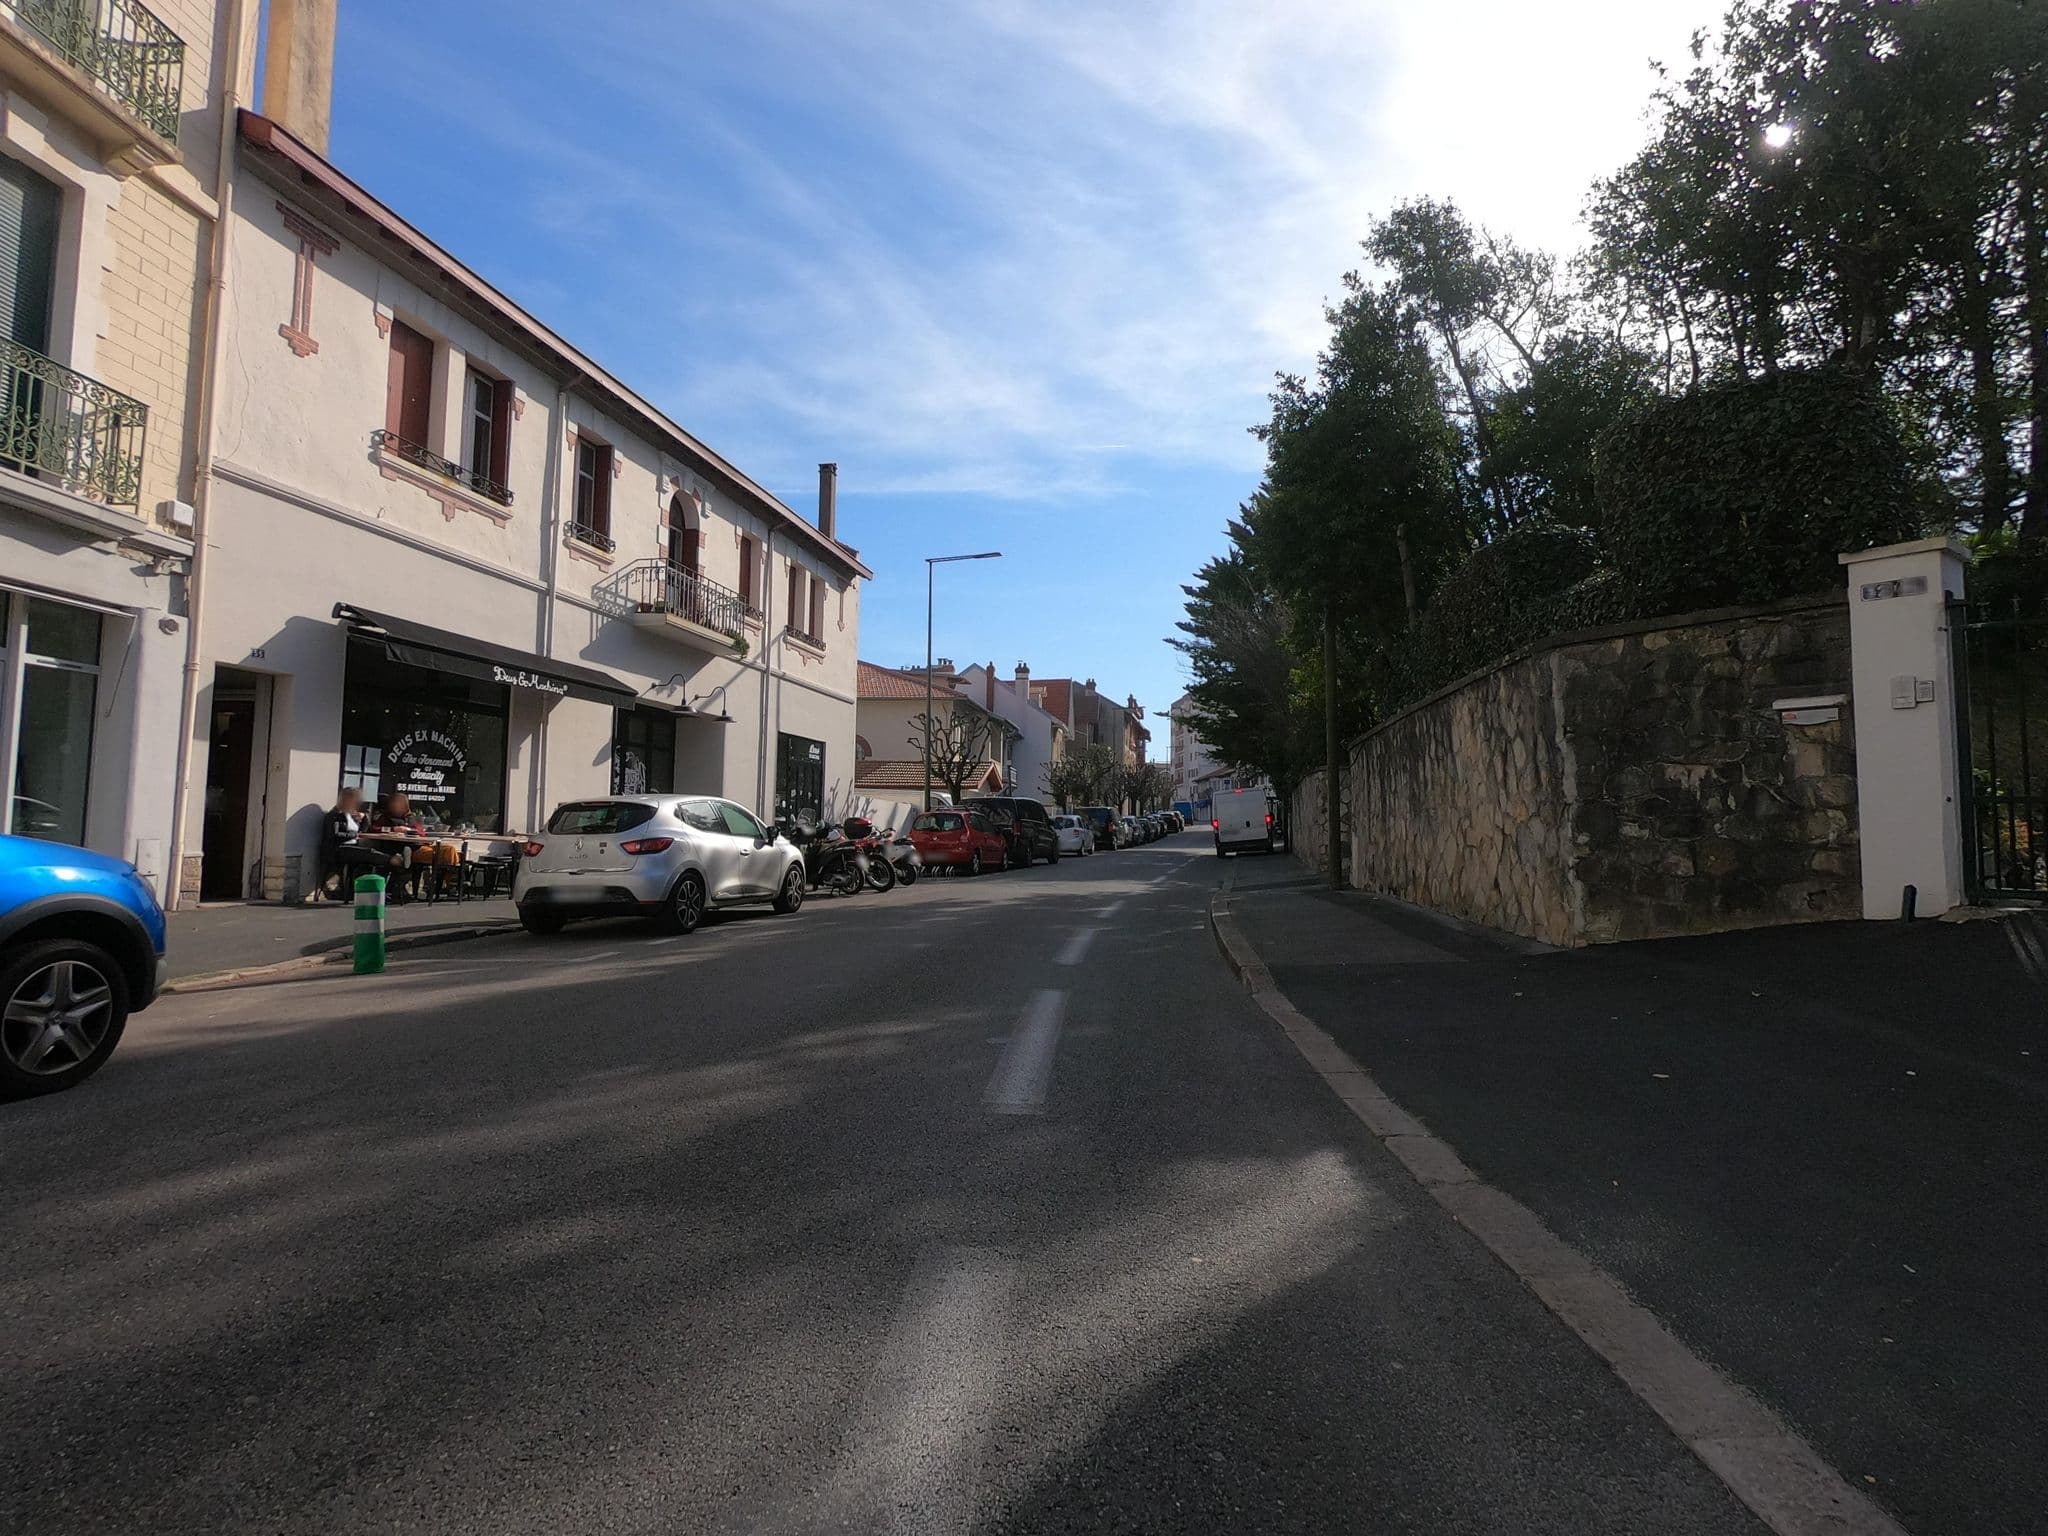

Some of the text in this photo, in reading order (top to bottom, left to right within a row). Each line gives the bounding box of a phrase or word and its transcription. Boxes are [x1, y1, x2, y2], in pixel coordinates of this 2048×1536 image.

[494, 666, 517, 684] Deus
[388, 734, 413, 763] DEUS
[415, 730, 428, 742] EX
[431, 730, 467, 770] MACHINA
[402, 753, 417, 764] The
[410, 768, 445, 785] Tenacity
[397, 783, 407, 791] 55
